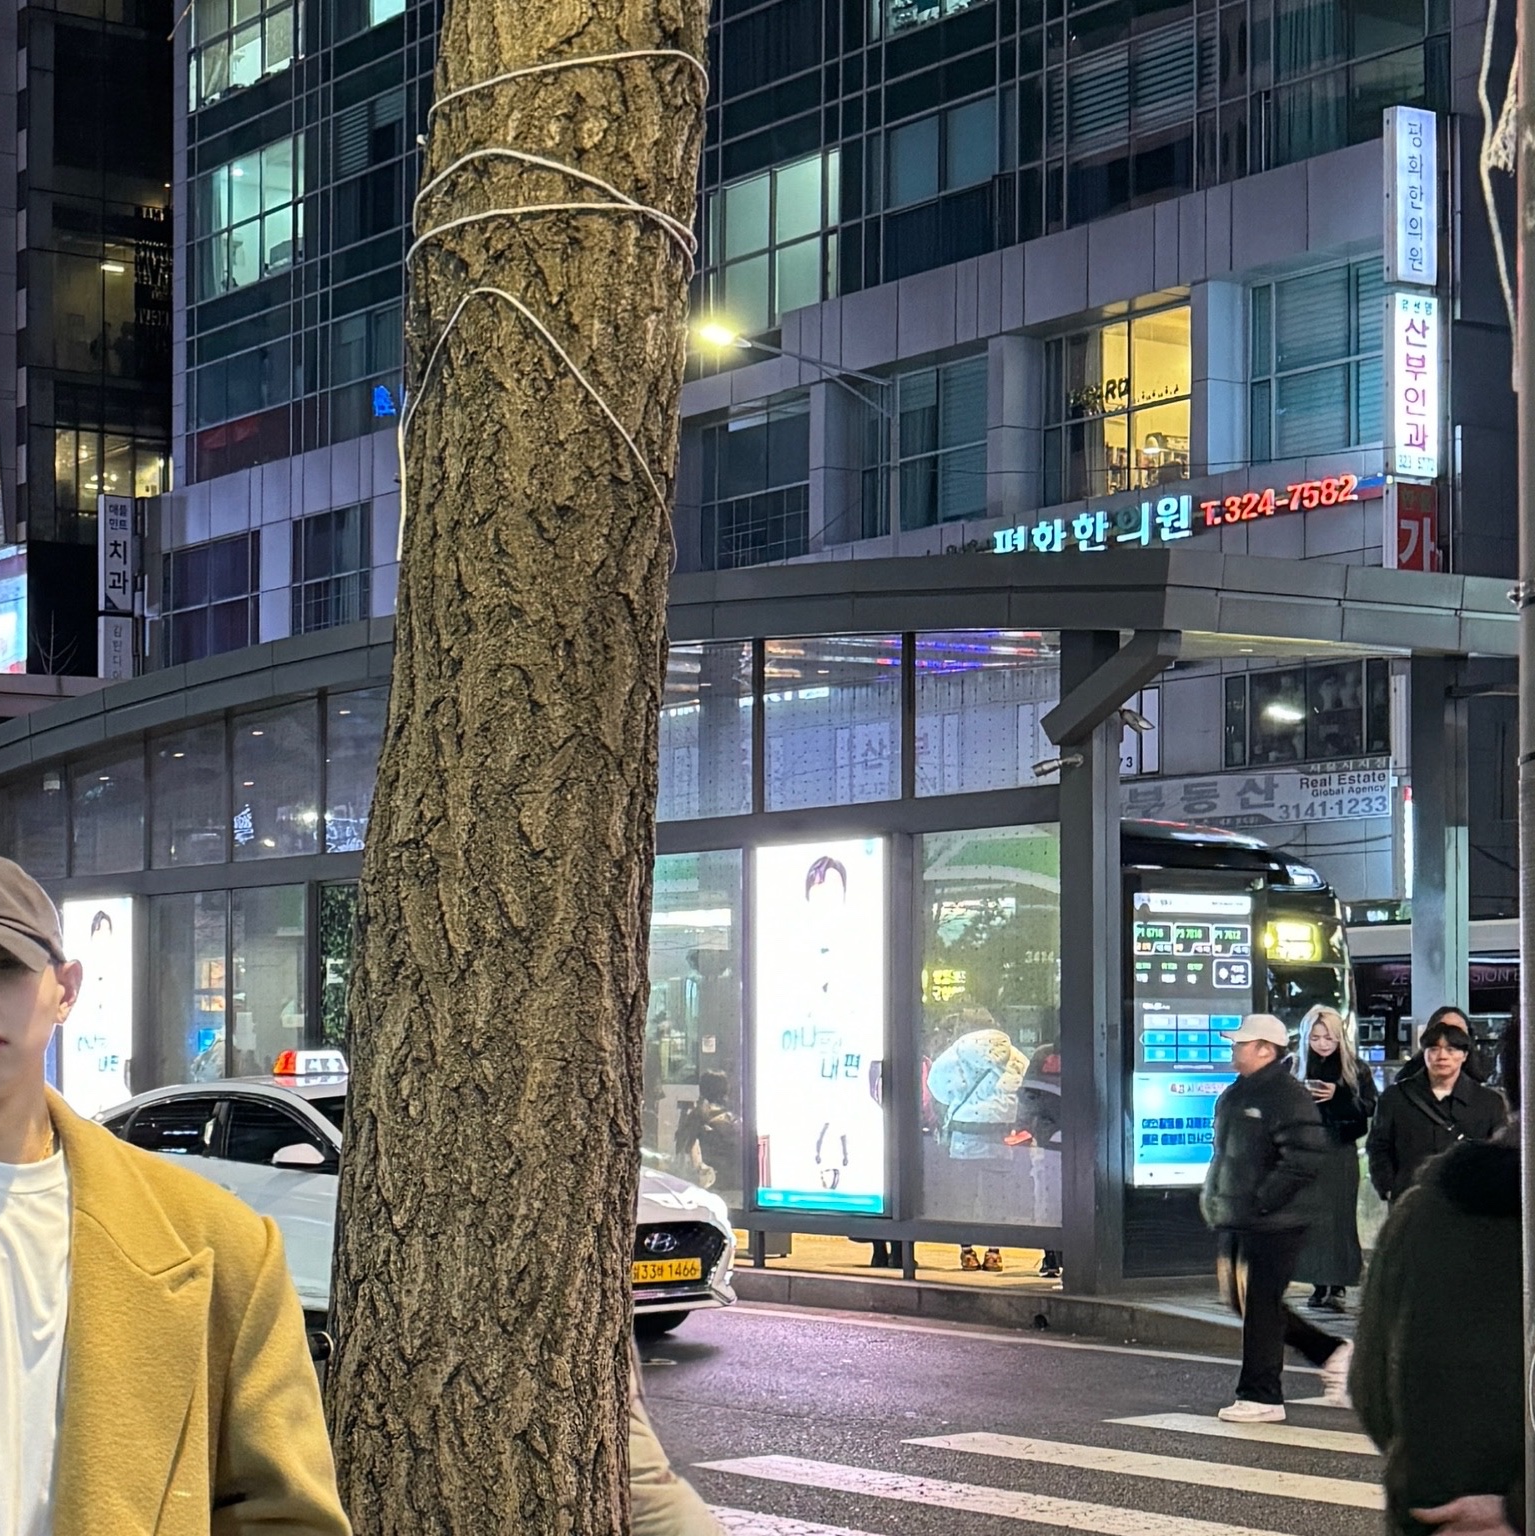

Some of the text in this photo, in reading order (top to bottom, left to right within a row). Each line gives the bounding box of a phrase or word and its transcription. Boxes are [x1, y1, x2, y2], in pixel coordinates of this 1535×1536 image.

[1408, 122, 1424, 273] 평화한의원
[1404, 318, 1430, 452] 산부인과
[1201, 473, 1359, 527] T.324-7582
[108, 540, 129, 595] 치과
[1124, 775, 1279, 819] 부동산
[1300, 771, 1387, 790] Real Estate
[1311, 784, 1386, 798] Global Agency
[1471, 971, 1511, 986] SION
[667, 1261, 699, 1279] 1466
